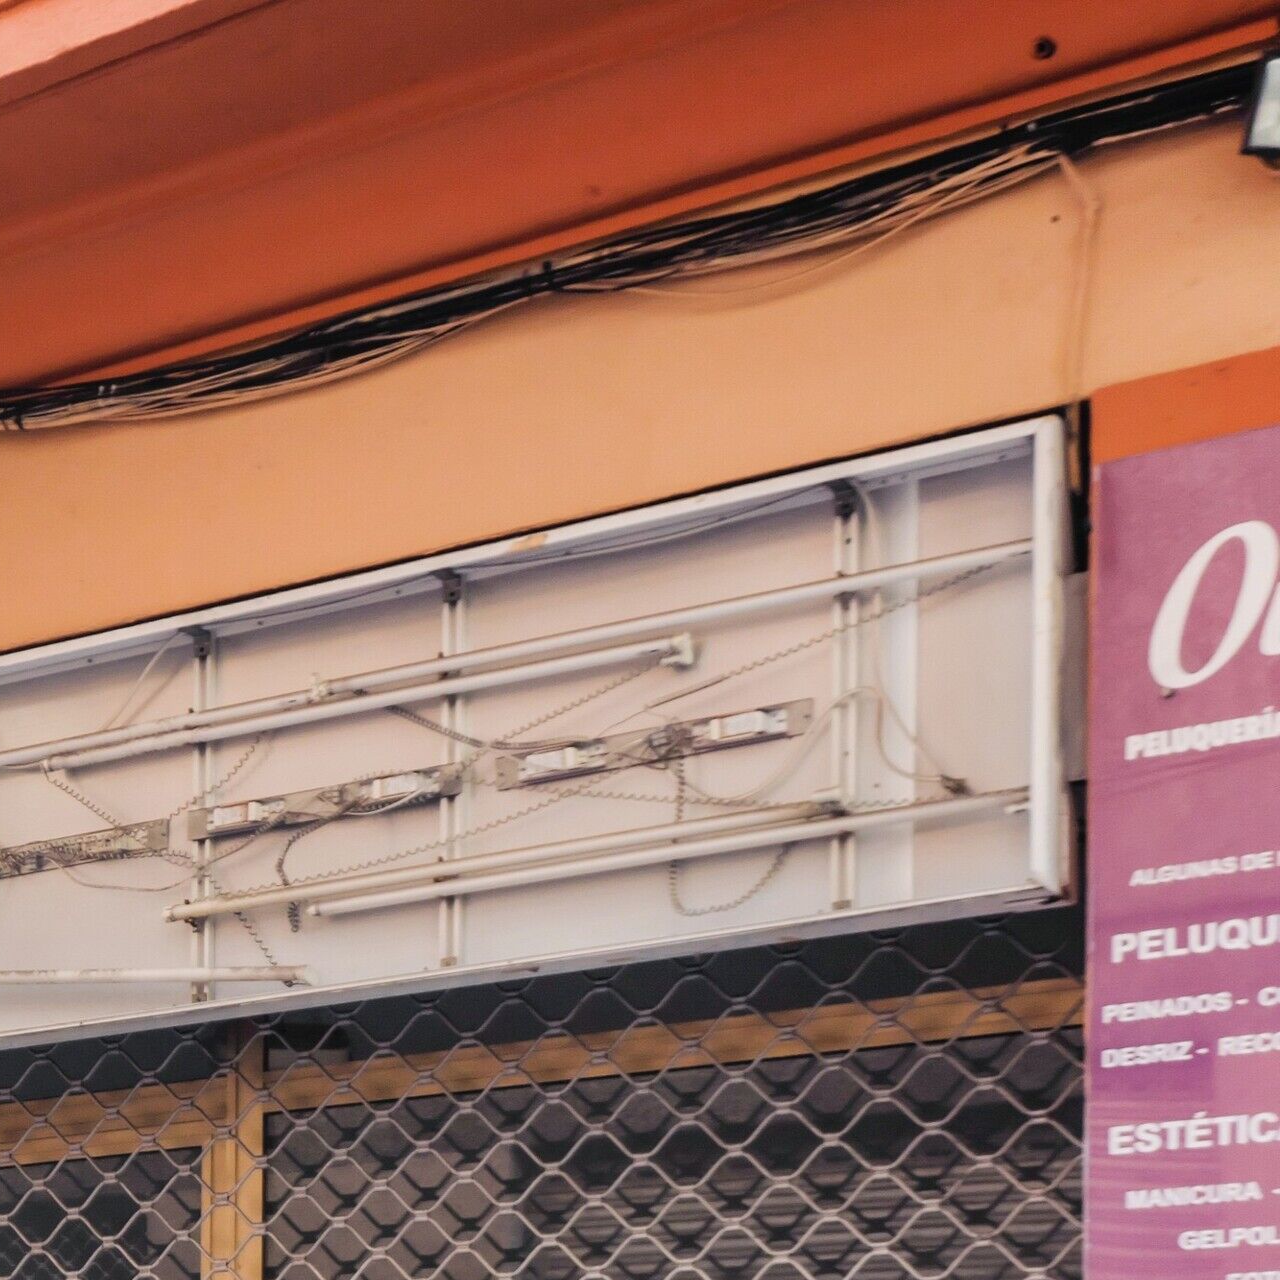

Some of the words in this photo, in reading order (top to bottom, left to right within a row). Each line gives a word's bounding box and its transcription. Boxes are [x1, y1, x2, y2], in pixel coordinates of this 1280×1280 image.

[1128, 855, 1238, 887] ALGUNAS
[1240, 850, 1275, 872] DE
[1111, 913, 1280, 963] PELUQU
[1101, 991, 1233, 1023] PEINADOS
[1100, 1041, 1194, 1068] DESRIZ
[1107, 1112, 1280, 1156] ESTÉTIC
[1124, 1181, 1264, 1210] MANICURA
